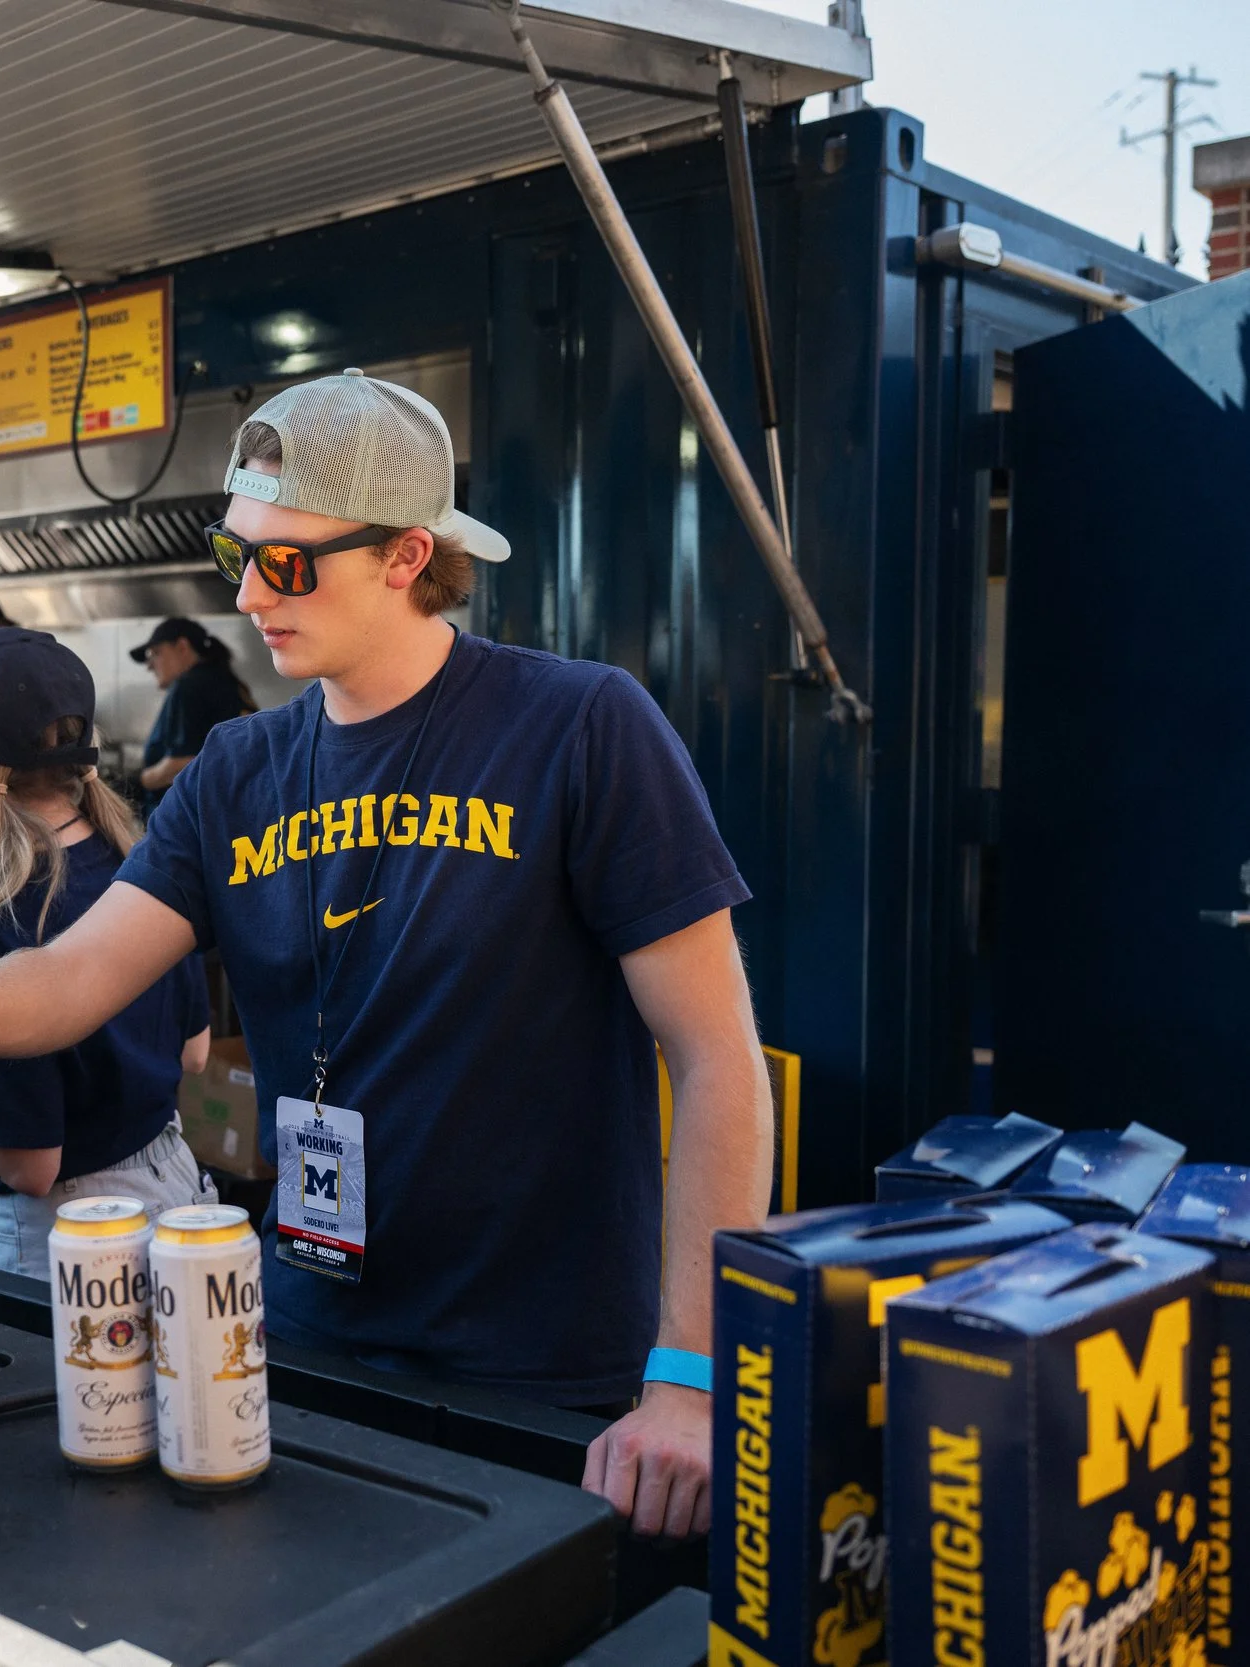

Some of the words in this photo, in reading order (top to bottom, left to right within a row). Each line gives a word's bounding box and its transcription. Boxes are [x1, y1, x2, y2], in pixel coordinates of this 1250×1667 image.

[296, 1132, 343, 1156] WORKING
[305, 1164, 337, 1200] M
[303, 1216, 325, 1230] SODEXO
[293, 1239, 308, 1252] GAME
[308, 1244, 313, 1253] 3
[316, 1245, 347, 1263] WISCONSIN
[323, 1237, 340, 1246] ACCESS
[317, 1256, 336, 1265] OCTOBER
[1075, 1297, 1193, 1507] M
[735, 1344, 773, 1640] MICHIGAN
